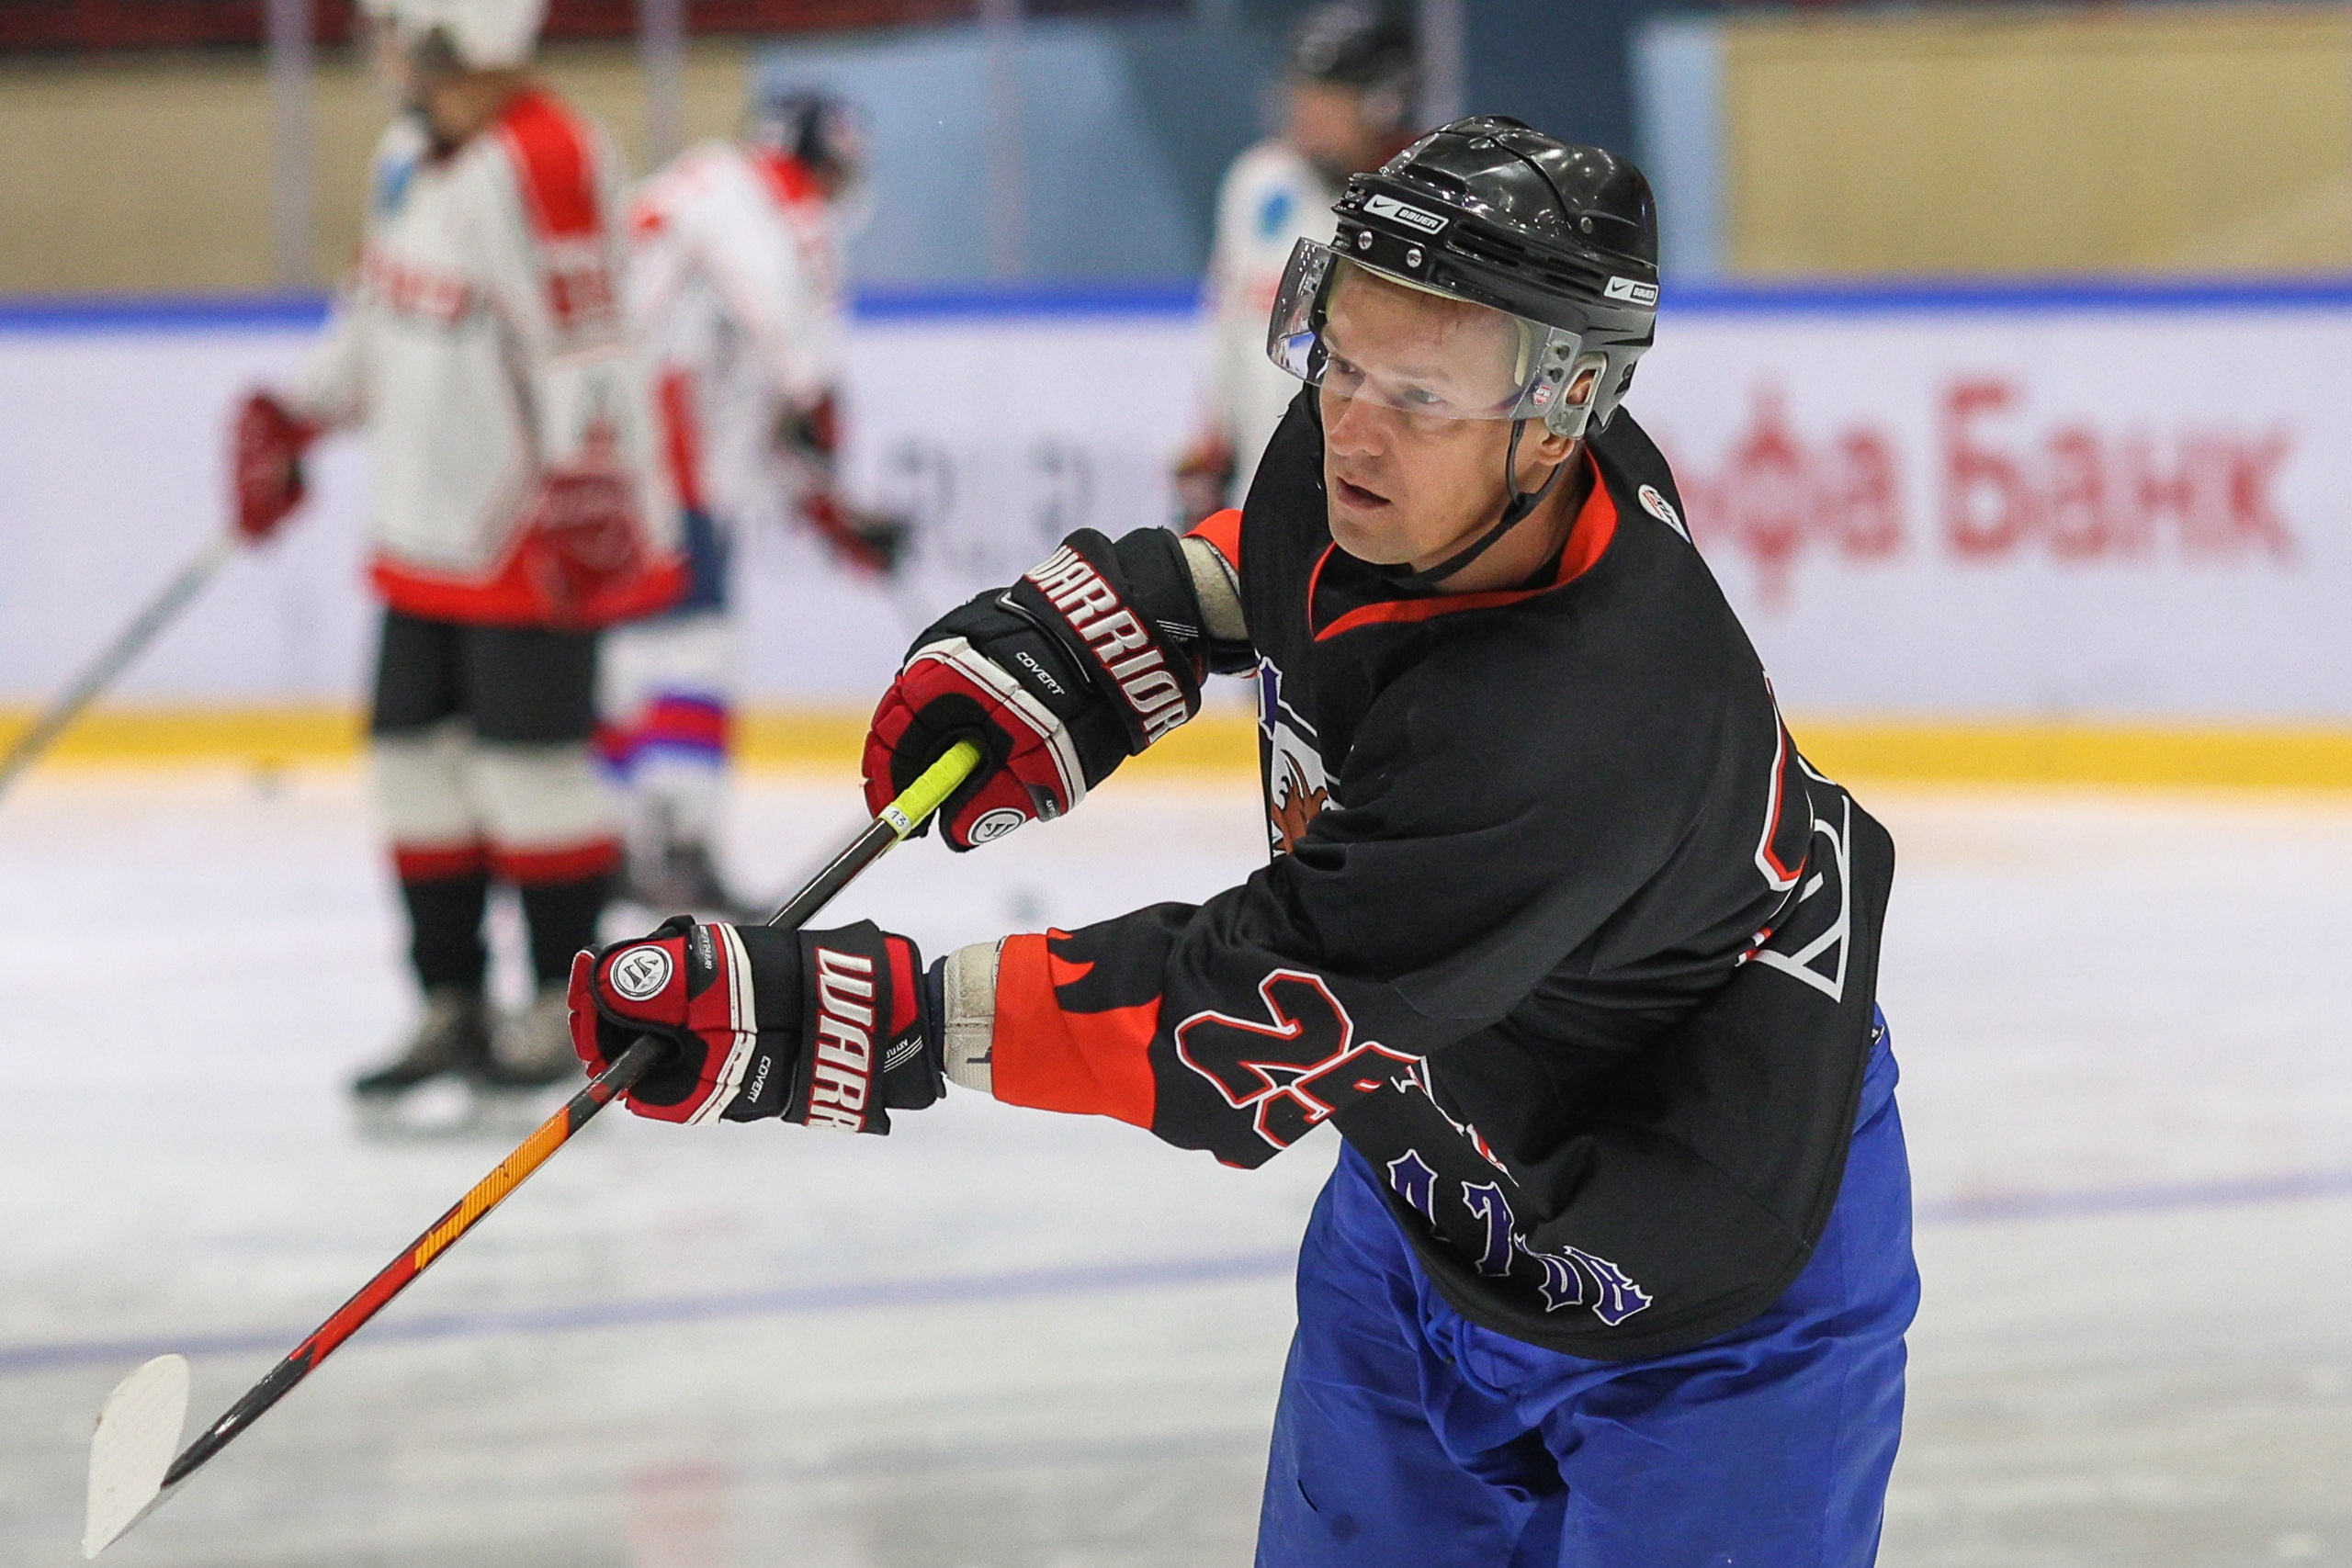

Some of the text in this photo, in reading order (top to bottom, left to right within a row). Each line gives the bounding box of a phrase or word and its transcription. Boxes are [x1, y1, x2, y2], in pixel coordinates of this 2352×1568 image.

[1397, 209, 1440, 229] BAUER
[1939, 372, 2299, 565] Банк
[1023, 542, 1191, 746] WARRIOR
[1014, 649, 1066, 696] COVERT
[746, 1055, 772, 1104] COVERT
